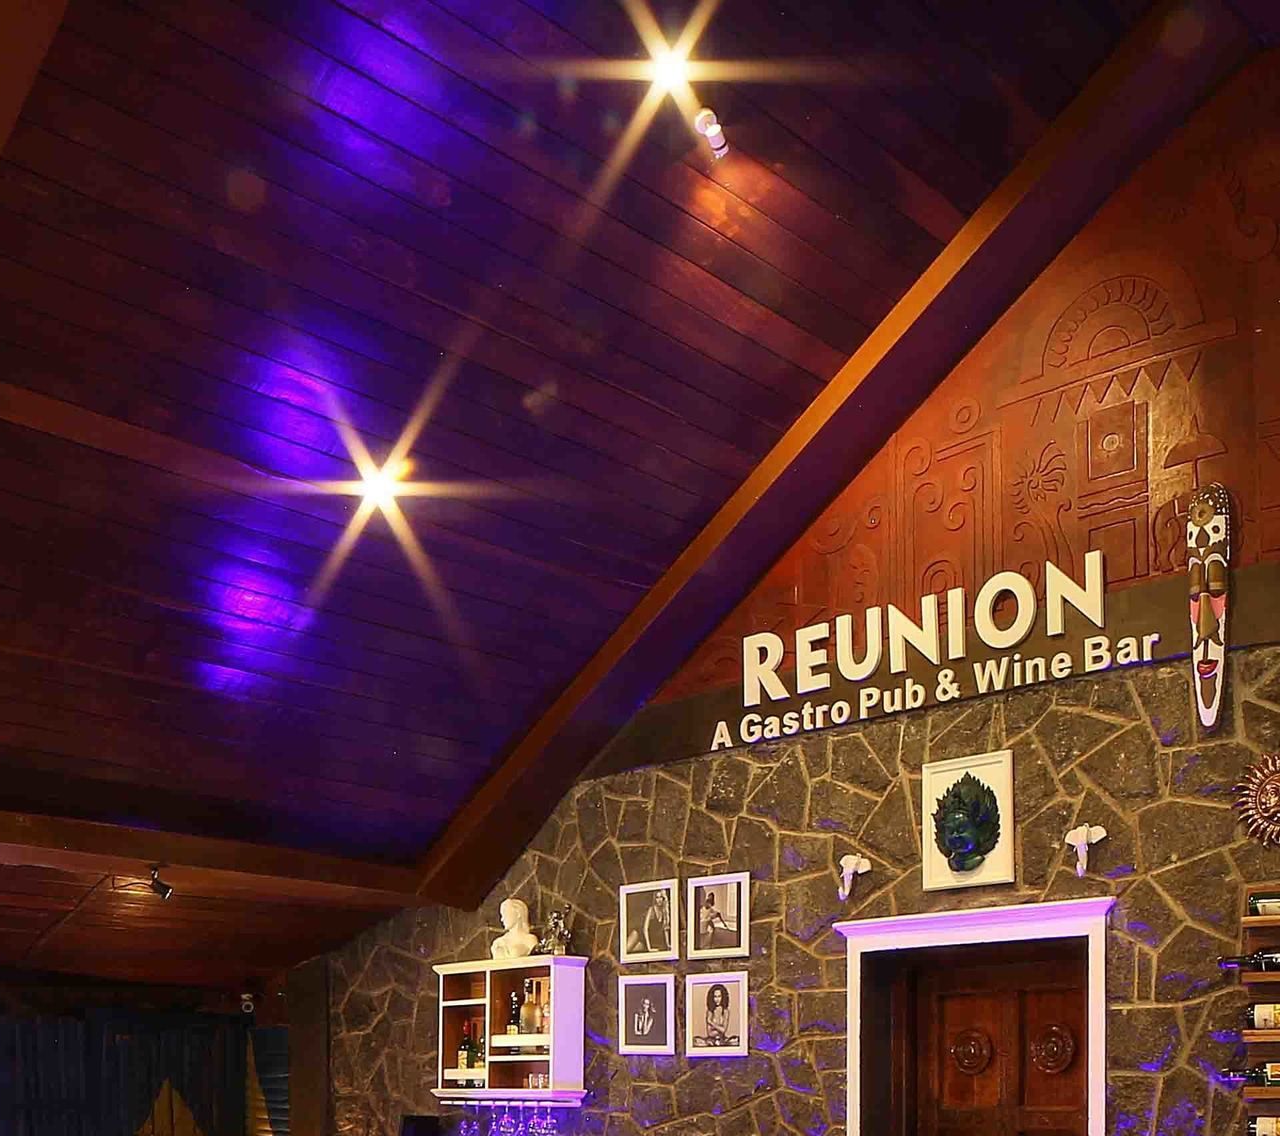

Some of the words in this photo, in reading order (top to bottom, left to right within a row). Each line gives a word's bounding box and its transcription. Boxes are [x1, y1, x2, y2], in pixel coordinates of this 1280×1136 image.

[710, 720, 733, 751] A
[740, 699, 851, 744] Gastro
[860, 679, 926, 714] Pub
[935, 667, 961, 702] &
[972, 651, 1073, 693] Wine
[1083, 632, 1162, 674] Bar
[742, 549, 1106, 707] REUNION
